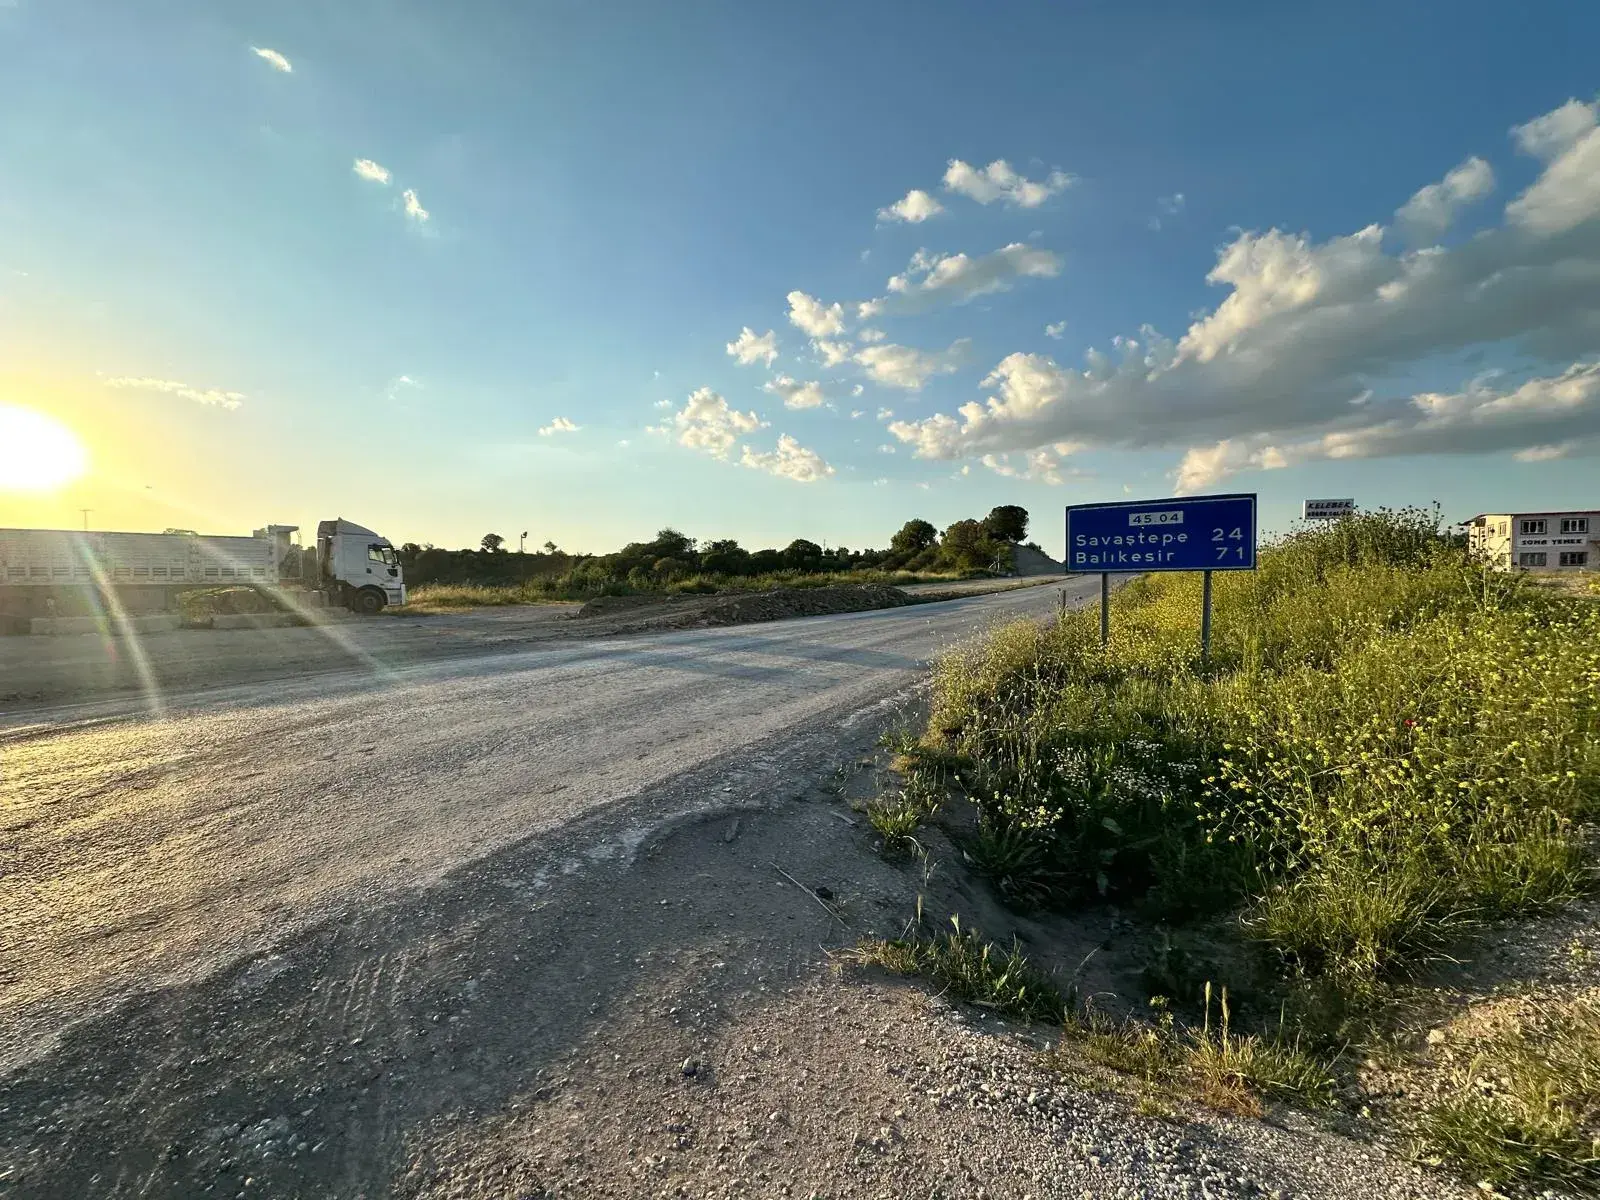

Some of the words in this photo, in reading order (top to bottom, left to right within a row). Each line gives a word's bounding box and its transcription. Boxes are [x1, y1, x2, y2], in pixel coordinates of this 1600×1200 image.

[1076, 532, 1188, 547] Savaştepe
[1211, 528, 1243, 542] 24
[1076, 550, 1175, 564] Balıkesir
[1215, 547, 1244, 560] 71
